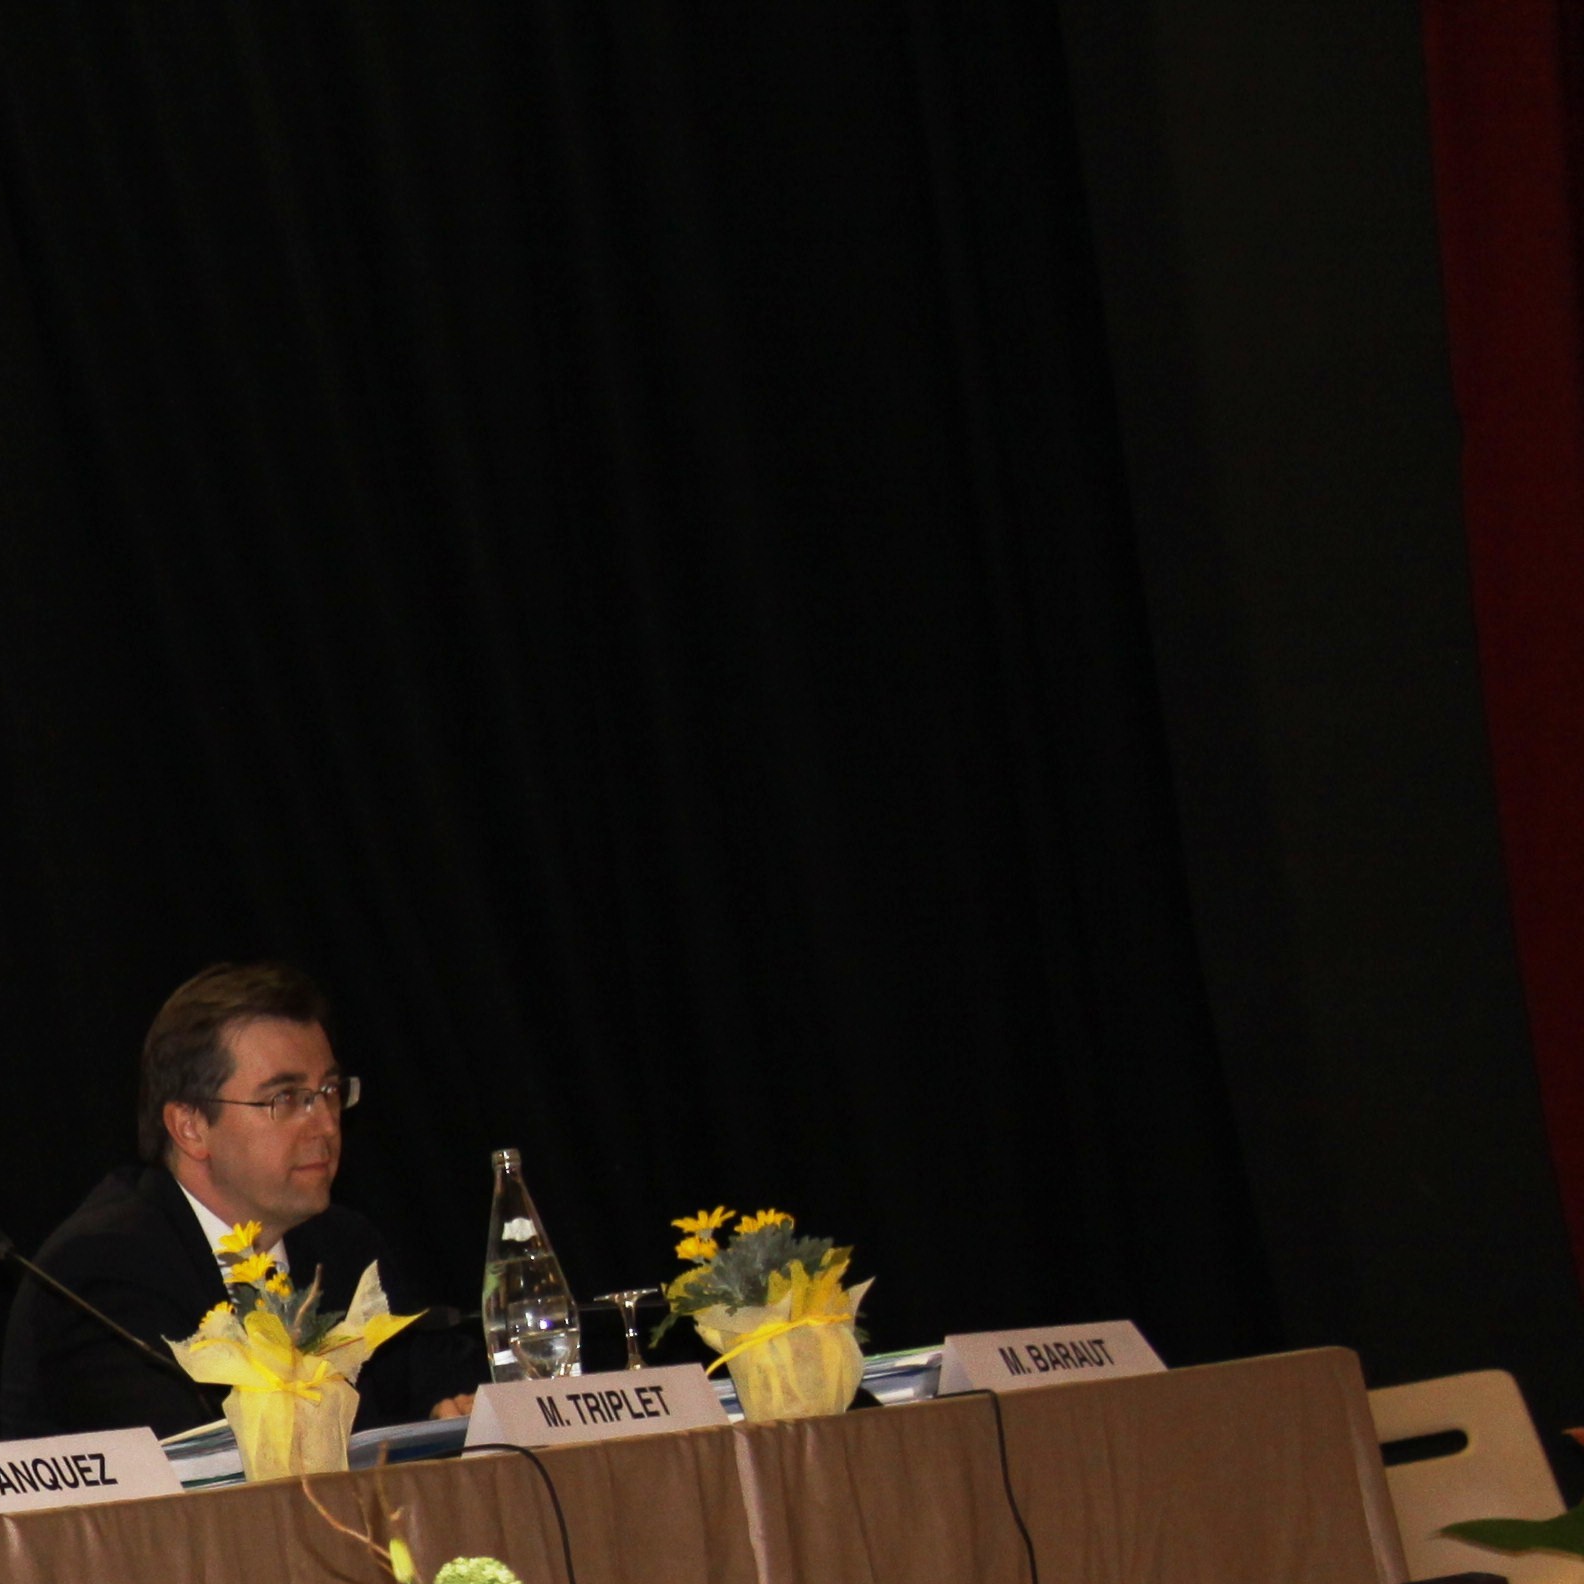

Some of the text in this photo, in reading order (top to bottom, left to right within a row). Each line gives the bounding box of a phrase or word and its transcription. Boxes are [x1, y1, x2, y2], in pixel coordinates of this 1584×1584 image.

[998, 1337, 1116, 1377] M. BARAUT
[535, 1385, 671, 1428] M. TRIPLET
